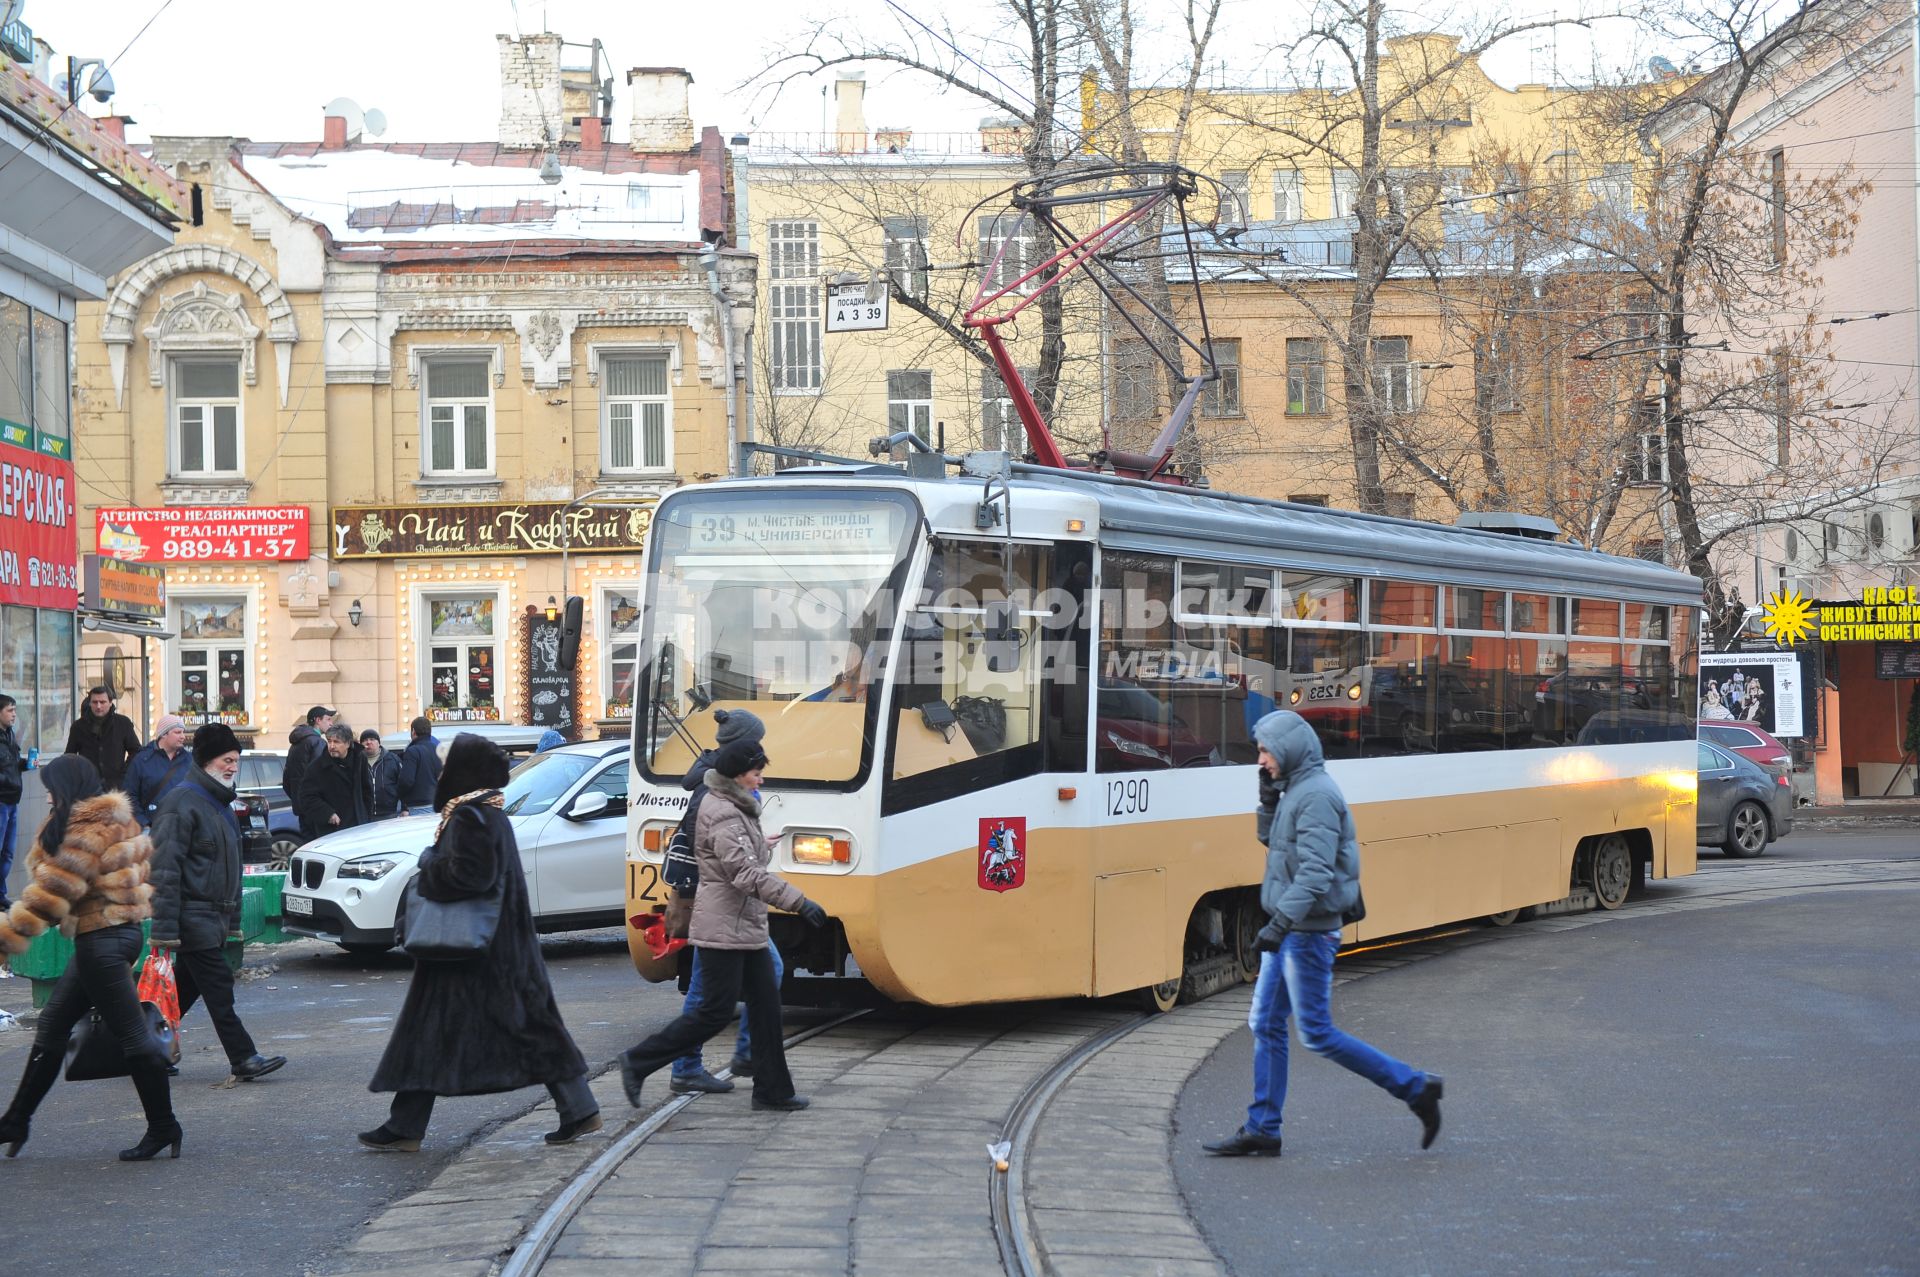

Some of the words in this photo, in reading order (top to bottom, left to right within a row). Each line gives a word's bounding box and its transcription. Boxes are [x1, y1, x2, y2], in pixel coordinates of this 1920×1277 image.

[838, 297, 866, 307] ПОСАДКИ
[837, 311, 845, 321] А
[852, 309, 859, 320] 3
[867, 308, 881, 319] 39
[0, 462, 66, 527] ЕРСКАЯ
[99, 510, 182, 522] АГЕНТСТВО
[185, 508, 304, 522] НЕДВИЖИМОСТИ
[763, 513, 817, 527] ЧИСТЫЕ
[822, 513, 870, 526] ПРУДЫ
[398, 513, 468, 542] Чай
[478, 523, 494, 541] и
[700, 517, 736, 542] 39
[760, 528, 874, 541] УНИВЕРСИТЕТ
[163, 539, 296, 559] 989-41-37
[1863, 585, 1917, 605] КАФЕ
[1820, 606, 1873, 623] ЖИВУТ
[1820, 623, 1910, 641] ОСЕТИНСКИЕ
[1766, 656, 1793, 664] простоты
[180, 714, 205, 726] КУСНЫЙ
[636, 793, 688, 810] Мосгор
[1107, 778, 1149, 817] 1290
[630, 864, 672, 901] 12
